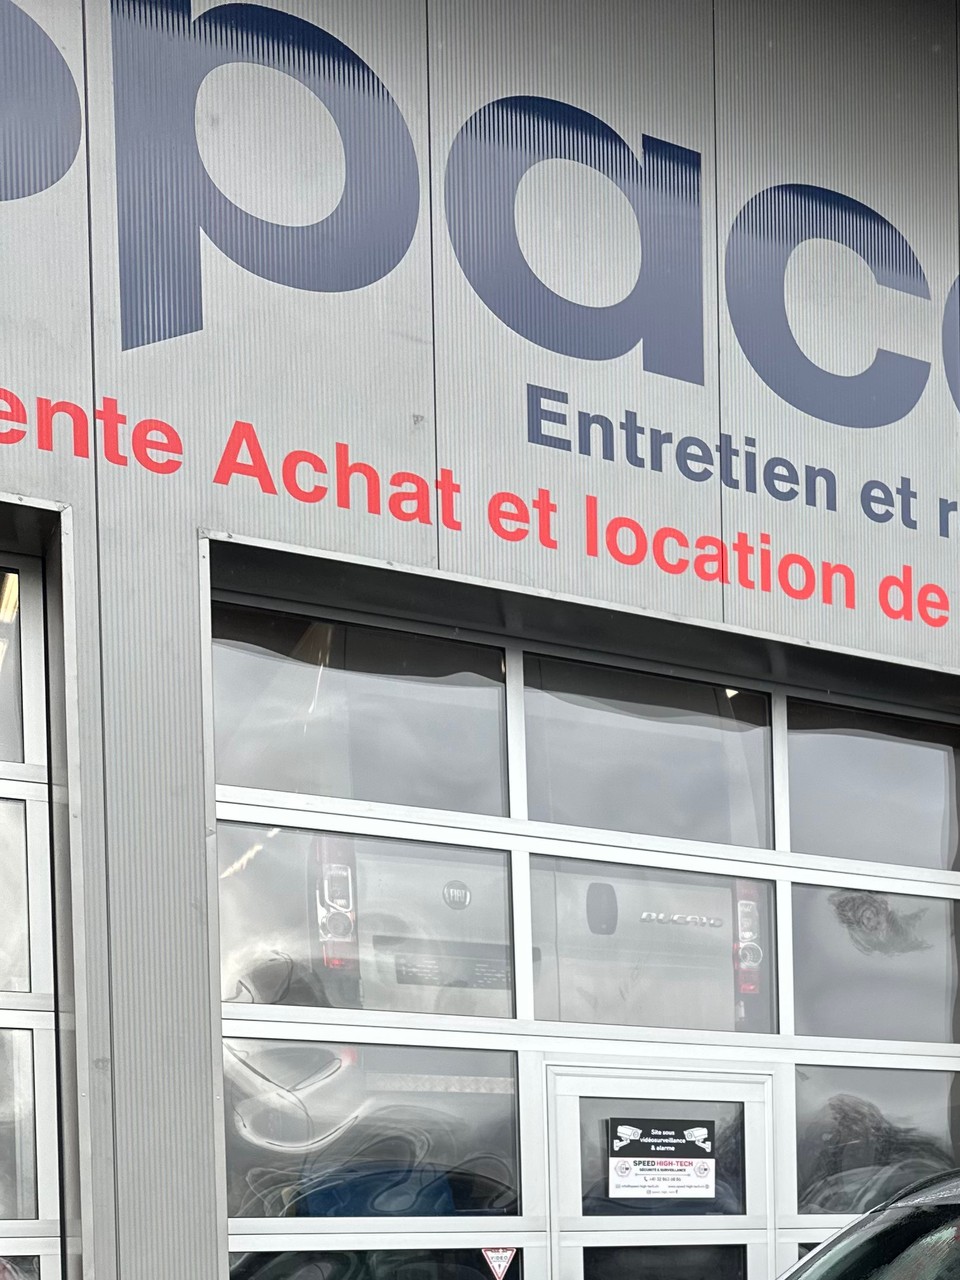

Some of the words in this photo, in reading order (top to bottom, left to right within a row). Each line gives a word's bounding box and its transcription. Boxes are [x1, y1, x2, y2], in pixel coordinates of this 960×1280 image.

[213, 421, 462, 532] Achat
[488, 489, 558, 550] et
[586, 496, 856, 610] location
[877, 565, 950, 628] de
[527, 384, 837, 512] Entretien
[861, 480, 919, 530] et
[651, 1128, 662, 1136] Site
